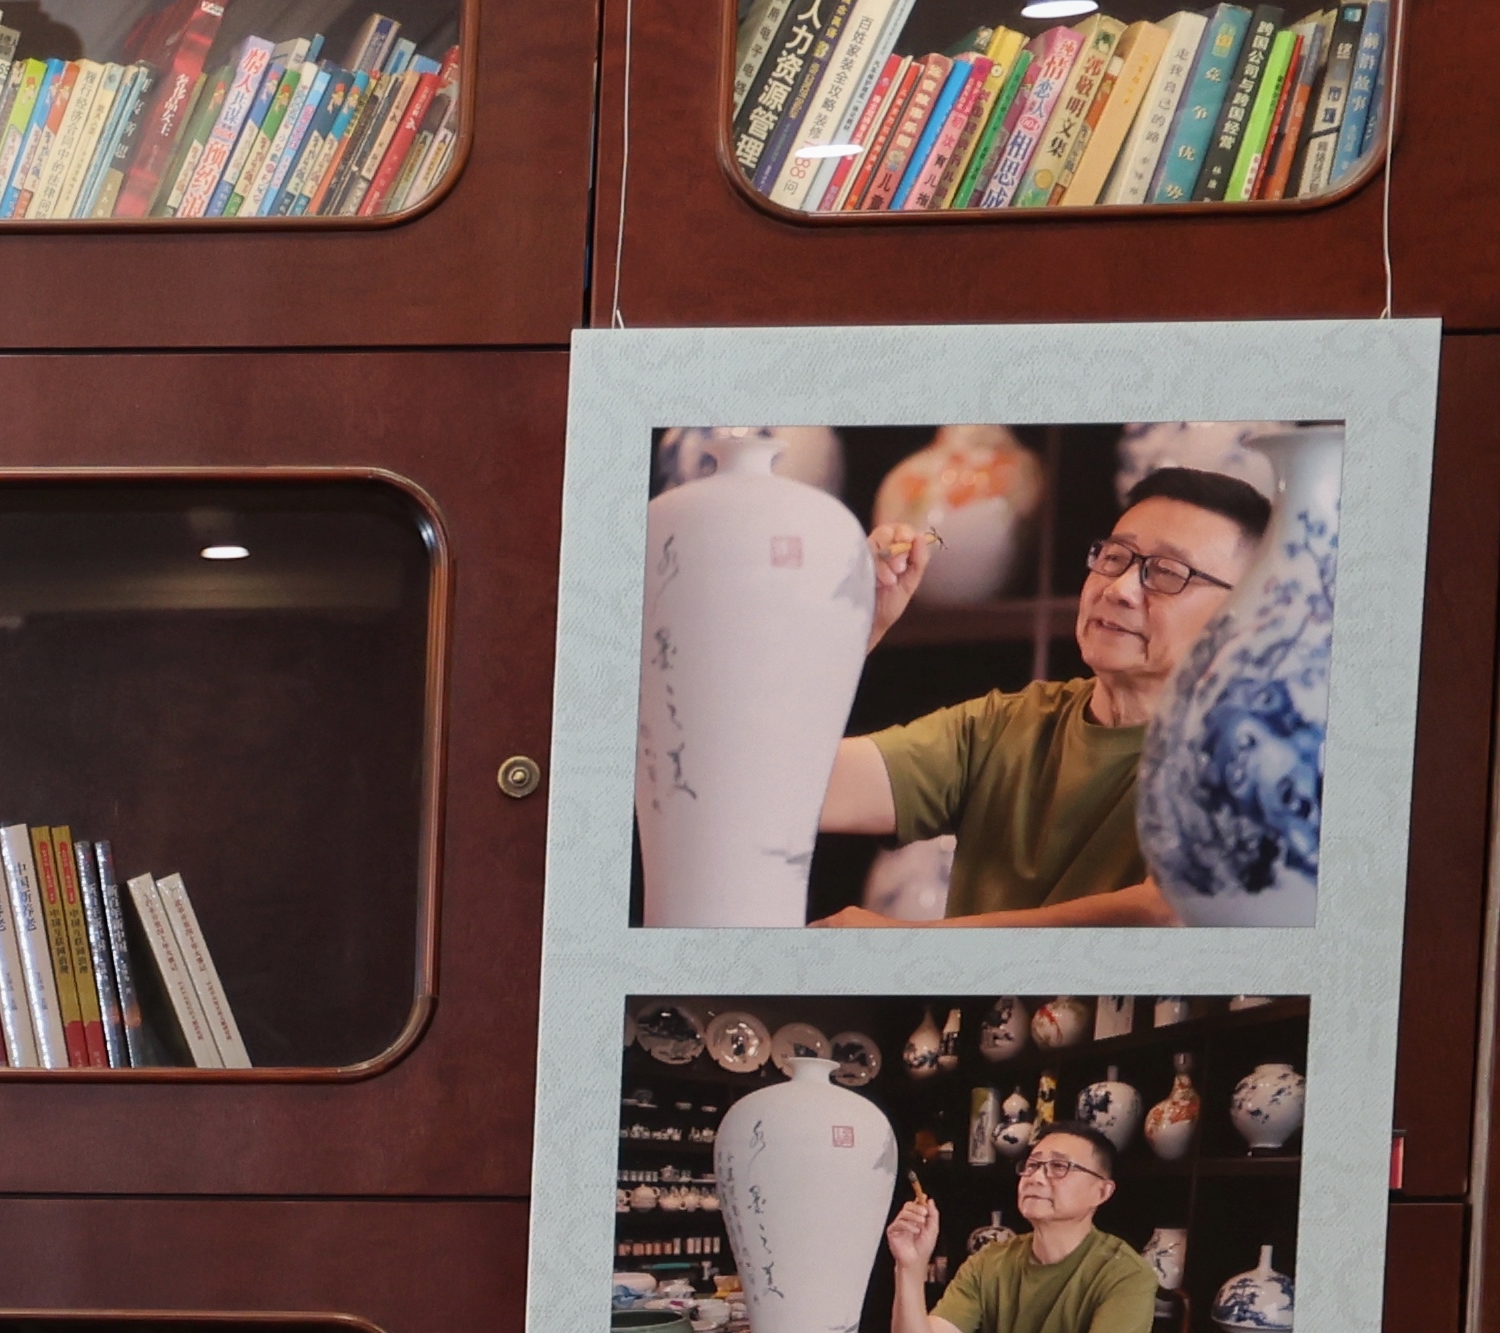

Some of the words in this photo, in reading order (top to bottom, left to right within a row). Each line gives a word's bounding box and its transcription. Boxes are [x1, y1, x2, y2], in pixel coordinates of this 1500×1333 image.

[735, 0, 822, 168] 人力资源管理
[823, 16, 874, 113] 百姓家装全攻略
[1219, 20, 1274, 150] 跨国公司与跨国经营
